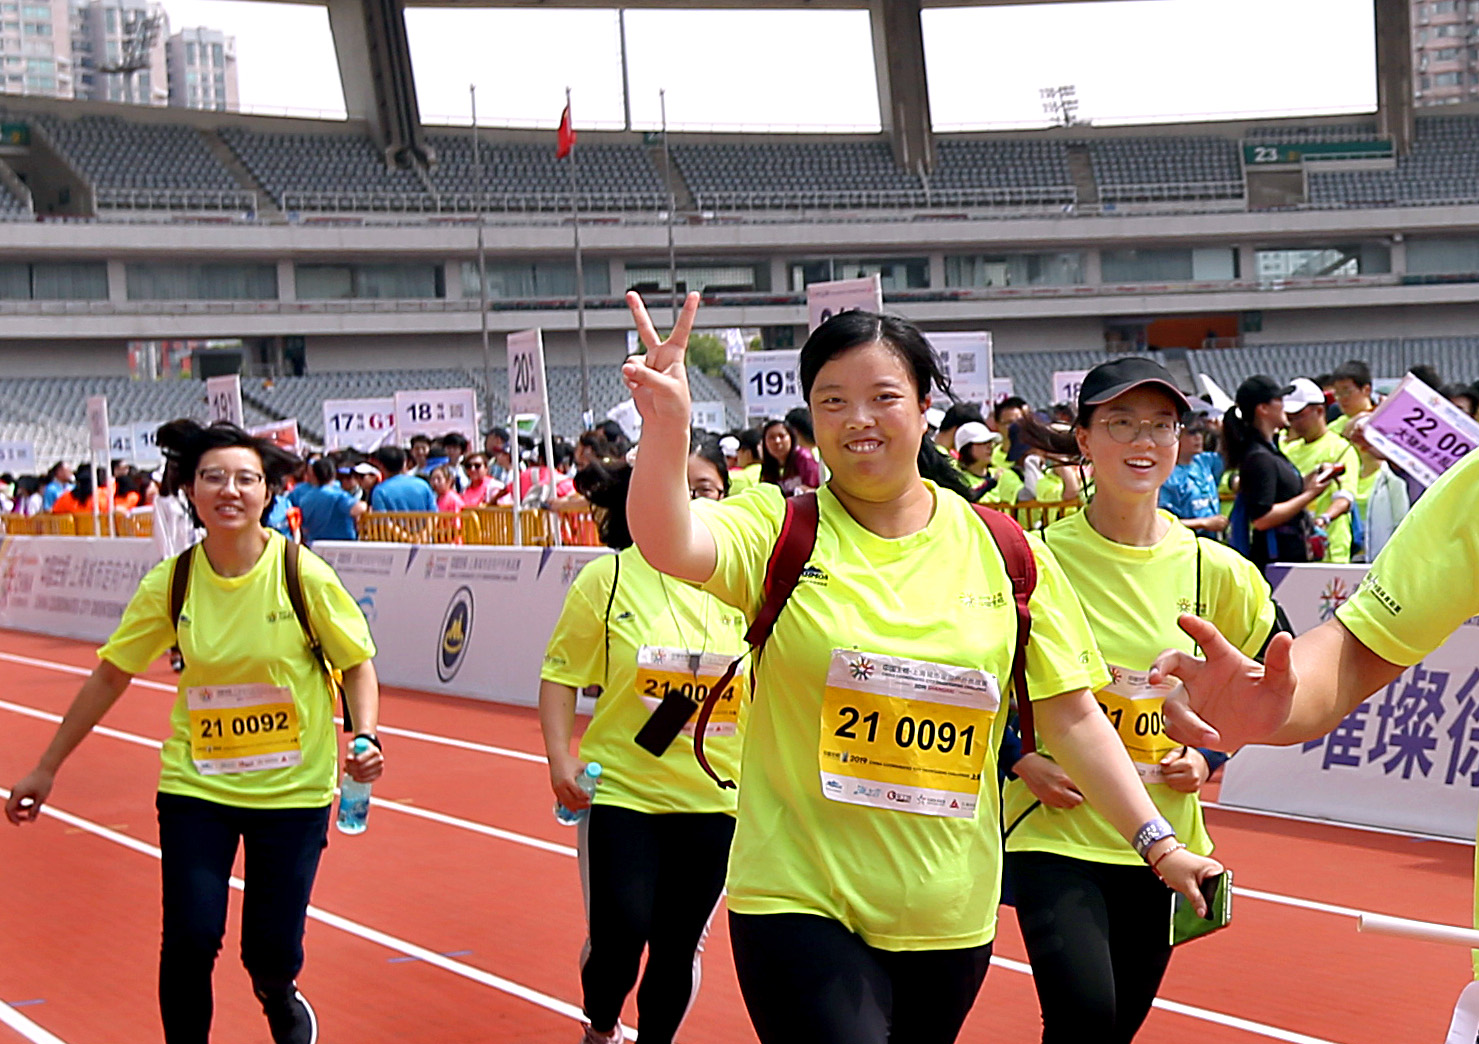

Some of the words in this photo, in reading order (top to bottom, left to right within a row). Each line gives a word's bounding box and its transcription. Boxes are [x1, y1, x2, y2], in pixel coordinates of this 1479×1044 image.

[1254, 147, 1278, 162] 23
[513, 352, 529, 394] 20
[750, 371, 784, 397] 19
[330, 413, 352, 432] 17
[406, 402, 432, 423] 18
[1403, 407, 1438, 438] 22
[1437, 433, 1470, 458] 00
[643, 679, 671, 701] 21
[681, 682, 735, 702] 004
[201, 718, 223, 739] 21
[232, 711, 289, 736] 0092
[834, 706, 880, 743] 21
[895, 716, 975, 756] 0091
[850, 755, 868, 765] 2019
